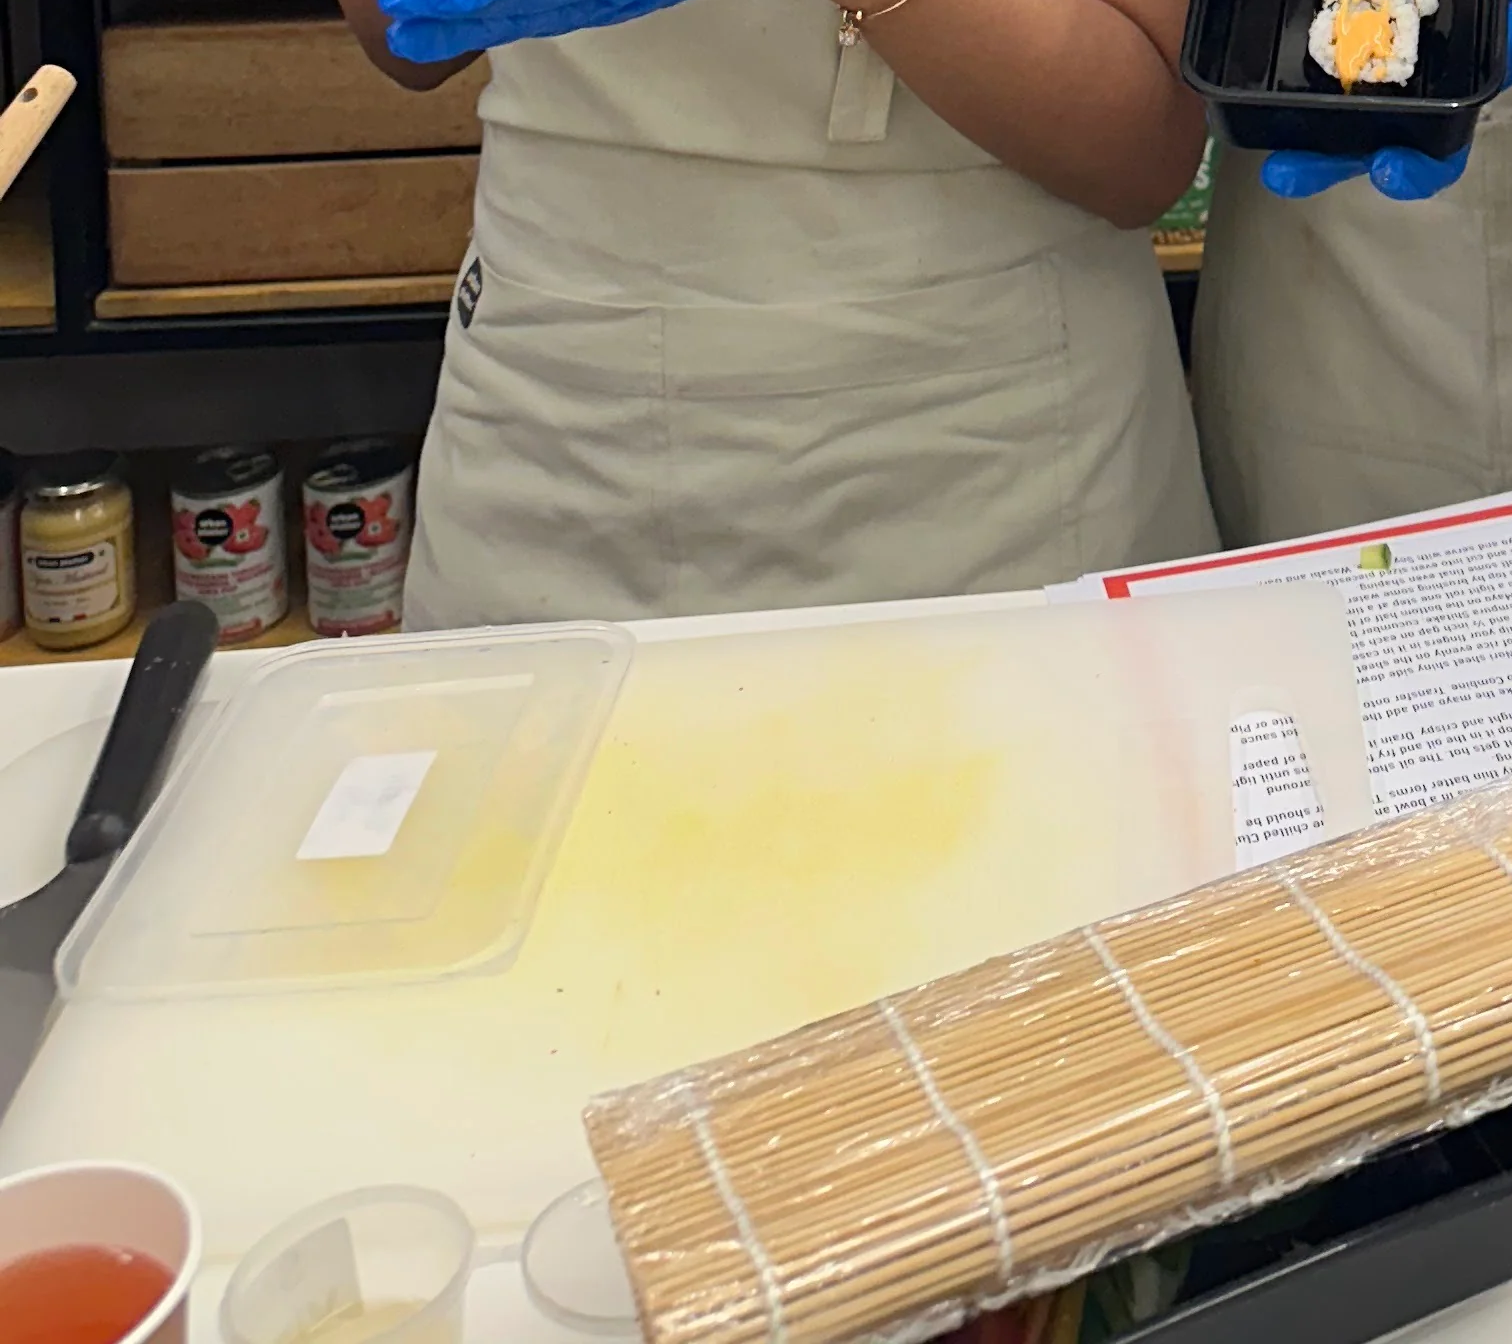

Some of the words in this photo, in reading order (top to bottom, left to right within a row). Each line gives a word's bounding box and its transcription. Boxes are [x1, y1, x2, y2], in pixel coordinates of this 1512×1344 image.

[1395, 687, 1444, 702] Transfer
[1439, 694, 1472, 706] mayo
[1363, 697, 1390, 709] onto
[1412, 701, 1434, 712] and
[1362, 711, 1382, 722] the
[1386, 706, 1408, 717] add
[1462, 716, 1484, 728] and
[1240, 733, 1277, 745] sauce
[1382, 731, 1414, 745] Drain
[1427, 738, 1442, 749] oil
[1446, 733, 1466, 743] the
[1400, 743, 1422, 754] and
[1473, 739, 1500, 753] gets
[1378, 747, 1397, 759] fry
[1419, 753, 1442, 763] The
[1243, 757, 1278, 770] paper
[1283, 755, 1295, 764] of
[1399, 758, 1415, 769] oil
[1259, 770, 1290, 783] until
[1473, 769, 1498, 781] thin
[1266, 779, 1310, 795] around
[1432, 775, 1469, 788] batter
